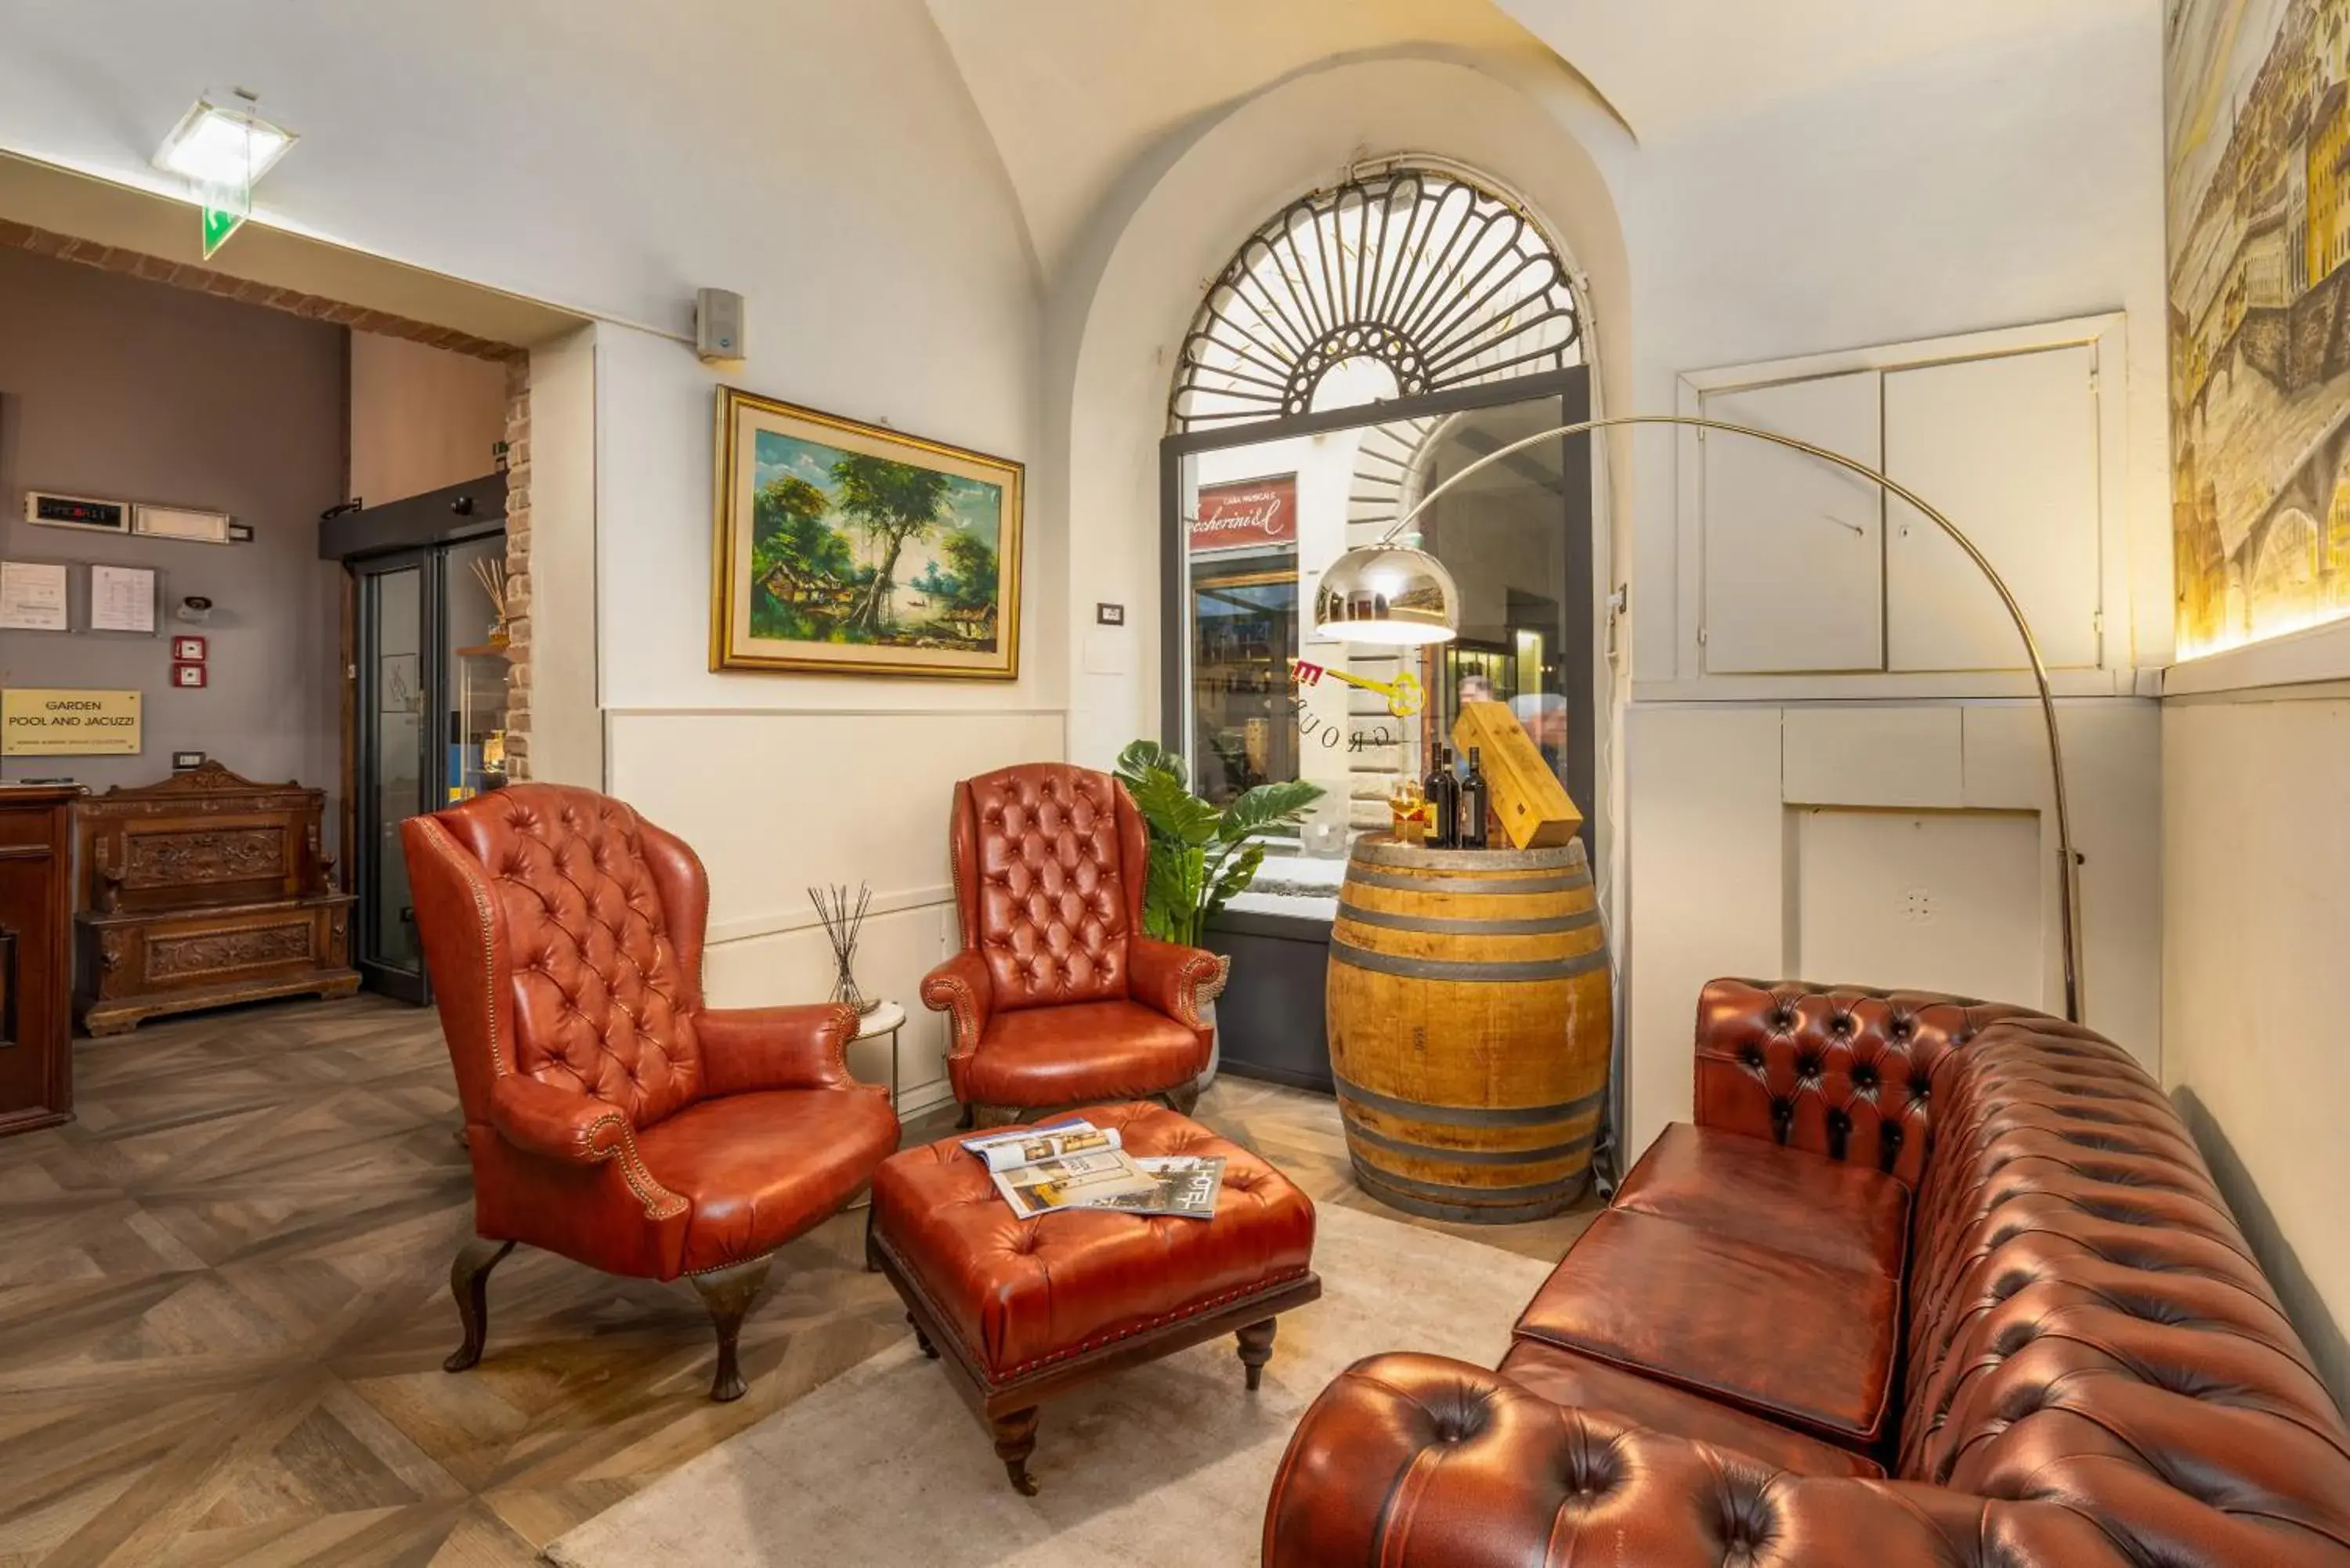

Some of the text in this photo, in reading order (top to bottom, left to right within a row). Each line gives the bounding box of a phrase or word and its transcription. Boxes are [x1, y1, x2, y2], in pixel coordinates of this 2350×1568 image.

[45, 701, 102, 710] GARDEN
[9, 717, 134, 726] POOL AND JACUZZI
